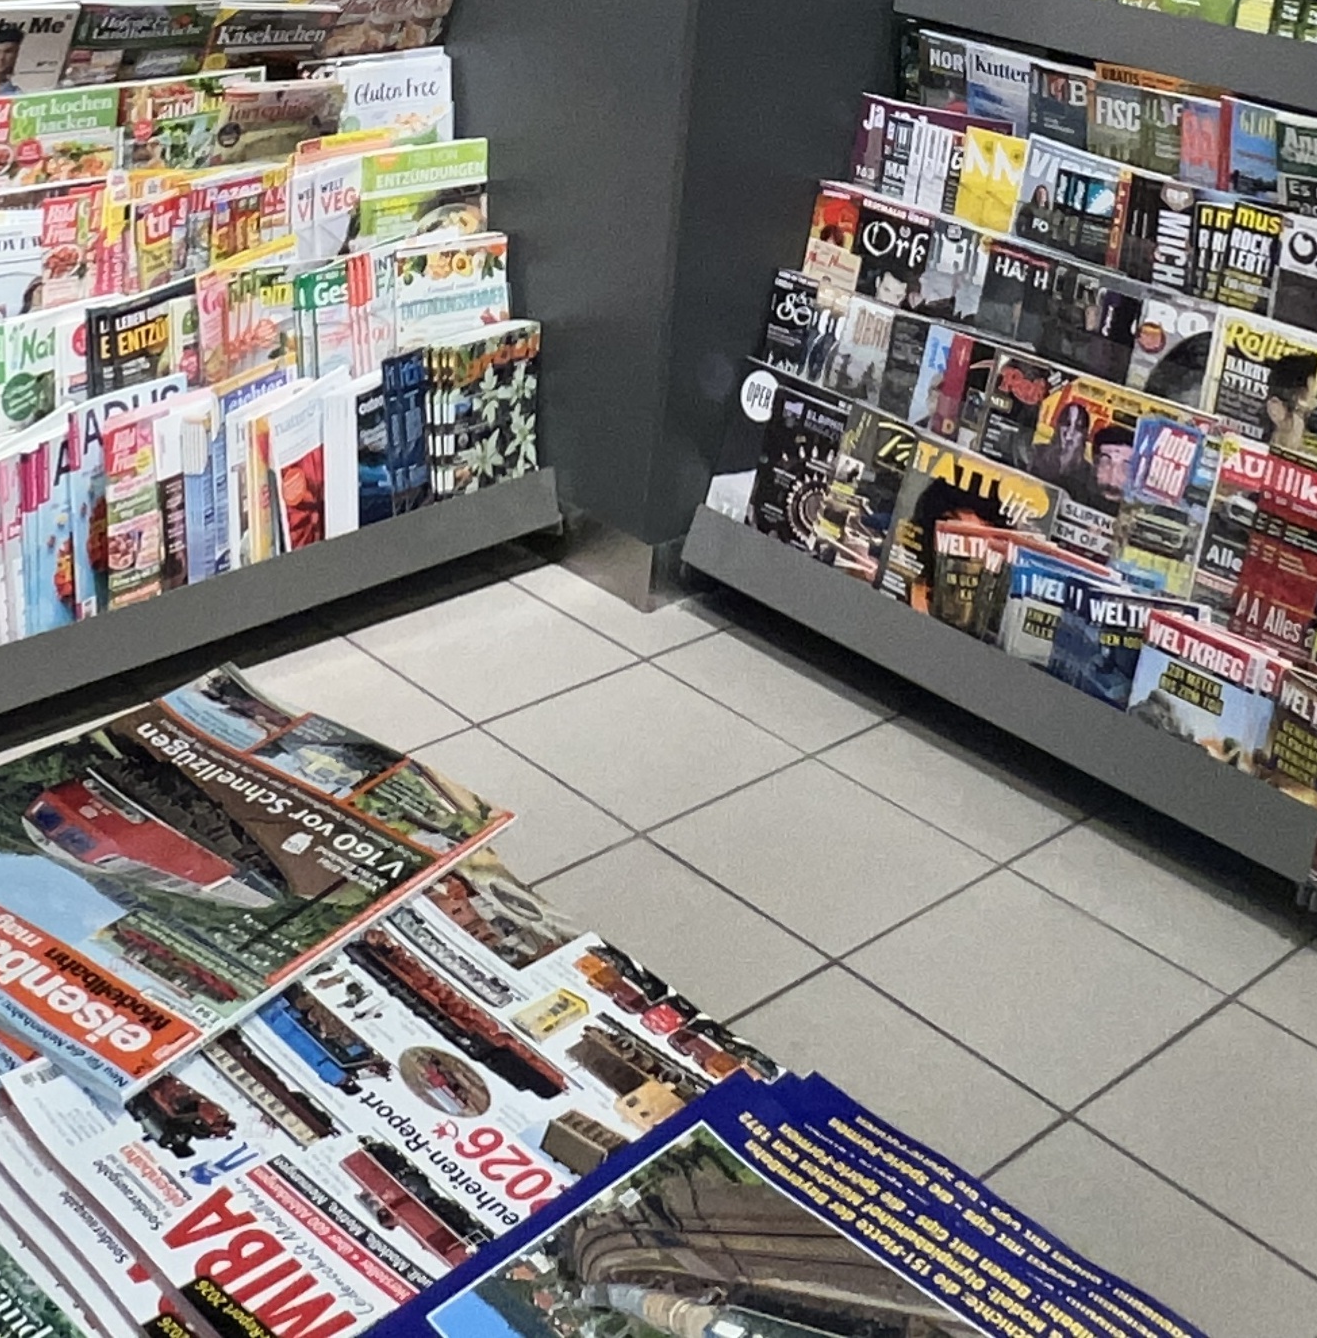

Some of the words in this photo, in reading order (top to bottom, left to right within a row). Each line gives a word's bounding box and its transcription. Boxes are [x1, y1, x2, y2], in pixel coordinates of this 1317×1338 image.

[28, 15, 67, 35] Me
[216, 24, 326, 49] Käsekuchen
[12, 100, 43, 121] Gut
[45, 94, 114, 118] kochen
[353, 79, 401, 108] Gluten
[404, 76, 442, 103] Free
[35, 113, 99, 133] backen
[375, 160, 487, 190] ENTZÜNDUNGEN
[322, 186, 359, 217] VEG
[999, 490, 1038, 528] life
[1148, 617, 1244, 684] WELTKRIEG
[137, 721, 293, 814] Schnellzügen
[288, 808, 333, 839] vor
[333, 833, 386, 870] 160
[382, 860, 405, 879] V
[44, 947, 172, 1032] Modellbahn
[163, 1185, 358, 1338] MIBA
[193, 1278, 229, 1307] 2026
